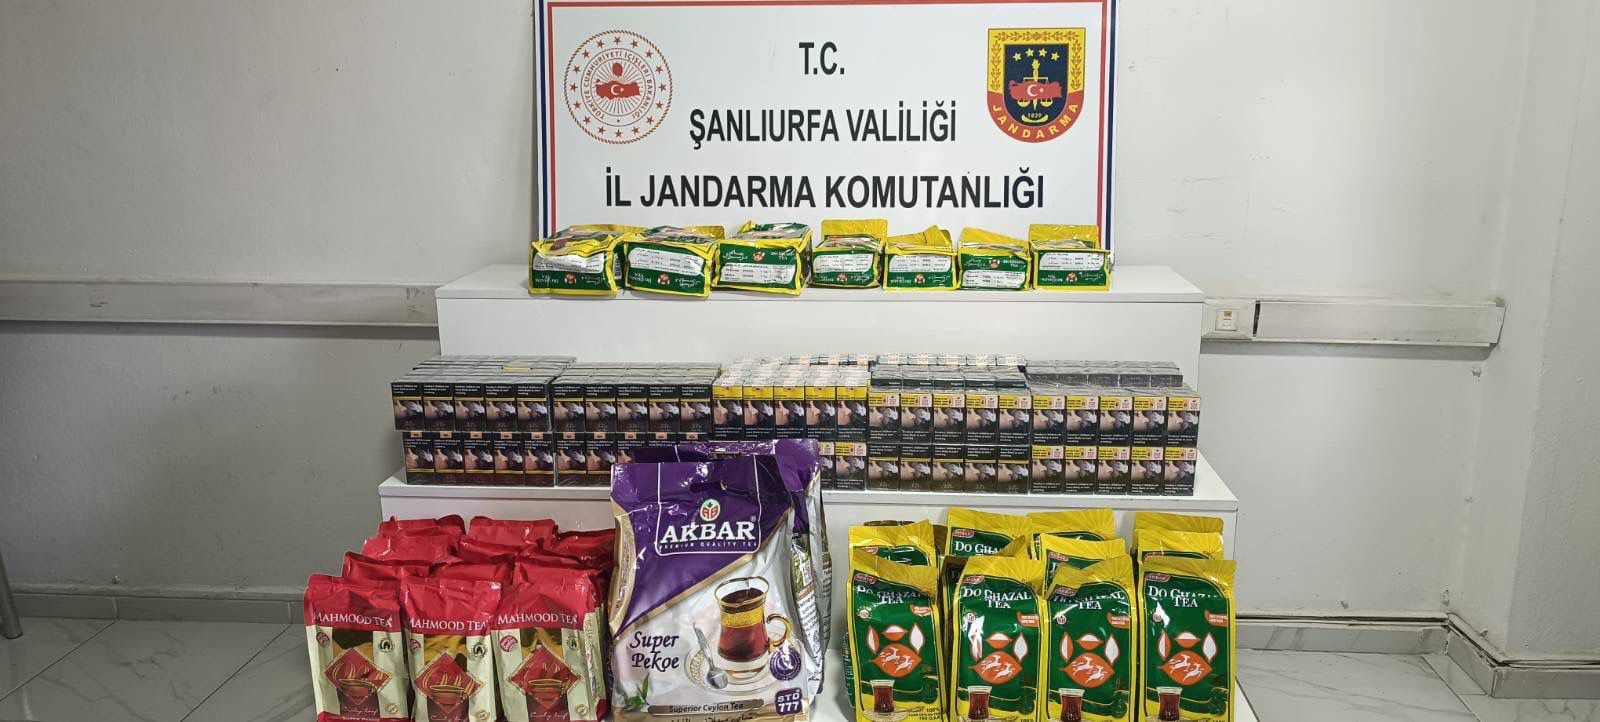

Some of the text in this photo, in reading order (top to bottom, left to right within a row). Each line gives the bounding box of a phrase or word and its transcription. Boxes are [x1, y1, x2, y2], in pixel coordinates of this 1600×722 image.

[799, 41, 845, 75] T.C.
[689, 100, 956, 150] ŞANLIURFA VALİLİĞİ
[992, 103, 1079, 139] JANDARMA
[606, 166, 1044, 209] İL JANDARMA KOMUTANLIĞI
[660, 521, 756, 544] AKBAR
[880, 596, 904, 605] TEA
[961, 587, 1032, 602] DO GHAZAL
[987, 600, 1012, 609] TEA
[1078, 600, 1103, 611] TEA
[1174, 596, 1198, 608] TEA
[312, 612, 371, 626] MAHMOOD
[409, 616, 486, 631] MAHMOOD TEA
[498, 613, 578, 625] MAHMOOD TEA
[629, 630, 680, 654] Super
[631, 650, 680, 673] Pekoe
[777, 691, 800, 703] STD
[669, 701, 744, 714] Superior Ceylon Tea
[778, 702, 799, 713] 777
